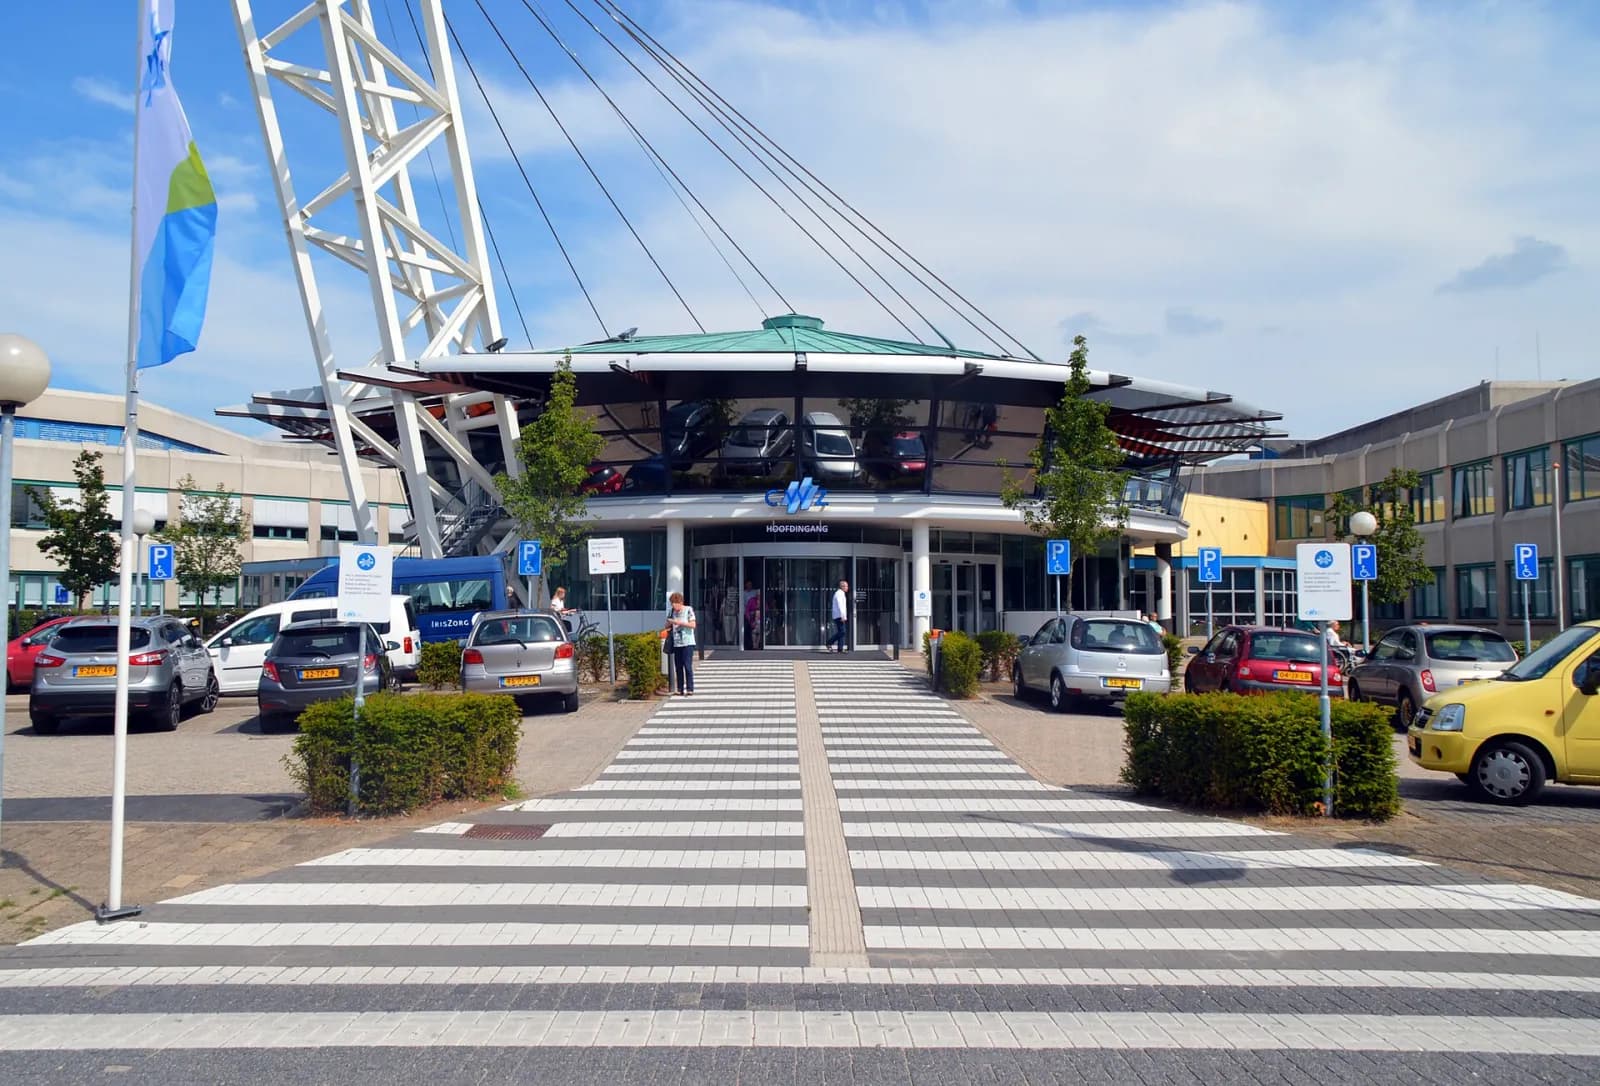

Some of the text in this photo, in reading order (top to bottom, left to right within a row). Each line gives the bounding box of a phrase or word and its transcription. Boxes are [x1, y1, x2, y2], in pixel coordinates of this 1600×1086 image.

[766, 525, 828, 533] HOOFDINGANG
[154, 547, 168, 565] P
[525, 543, 536, 560] P
[1053, 543, 1065, 560] P
[1203, 550, 1217, 568] P
[1357, 547, 1371, 565] P
[1520, 546, 1533, 564] P
